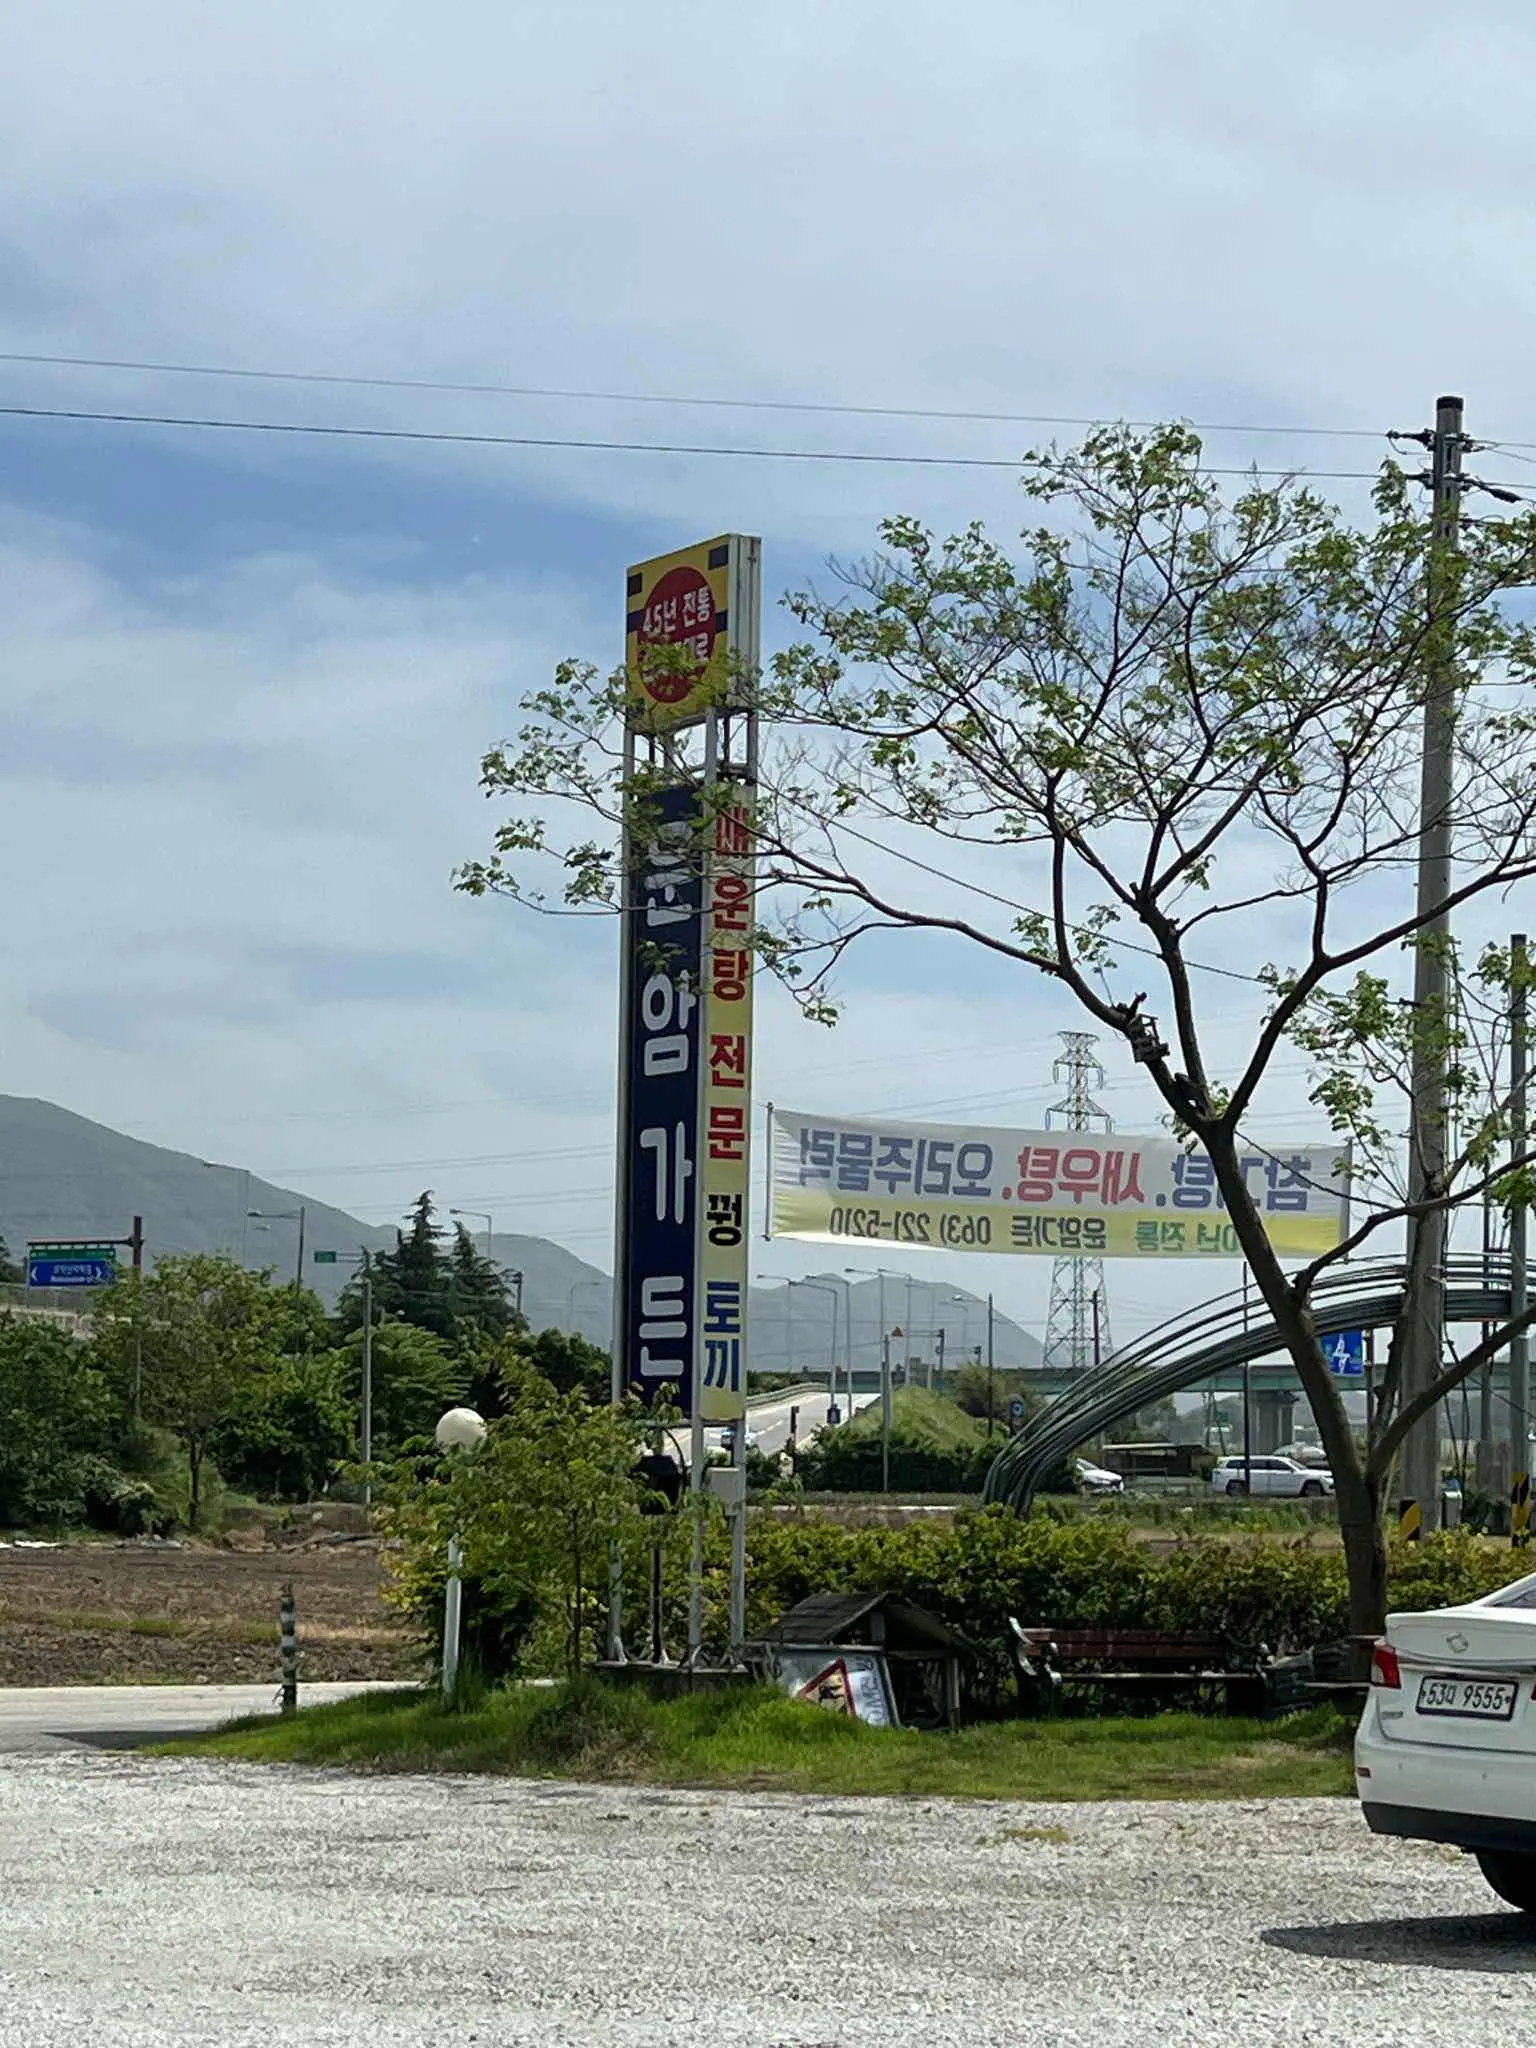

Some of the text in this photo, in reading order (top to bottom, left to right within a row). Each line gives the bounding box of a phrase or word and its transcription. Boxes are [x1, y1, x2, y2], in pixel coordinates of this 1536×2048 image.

[642, 585, 711, 635] 45년 전통
[708, 807, 750, 1160] 매운탕 전문
[639, 820, 697, 1378] 운암가든
[706, 1193, 743, 1248] 꿩
[704, 1280, 740, 1393] 토끼
[1462, 1684, 1506, 1710] 9555
